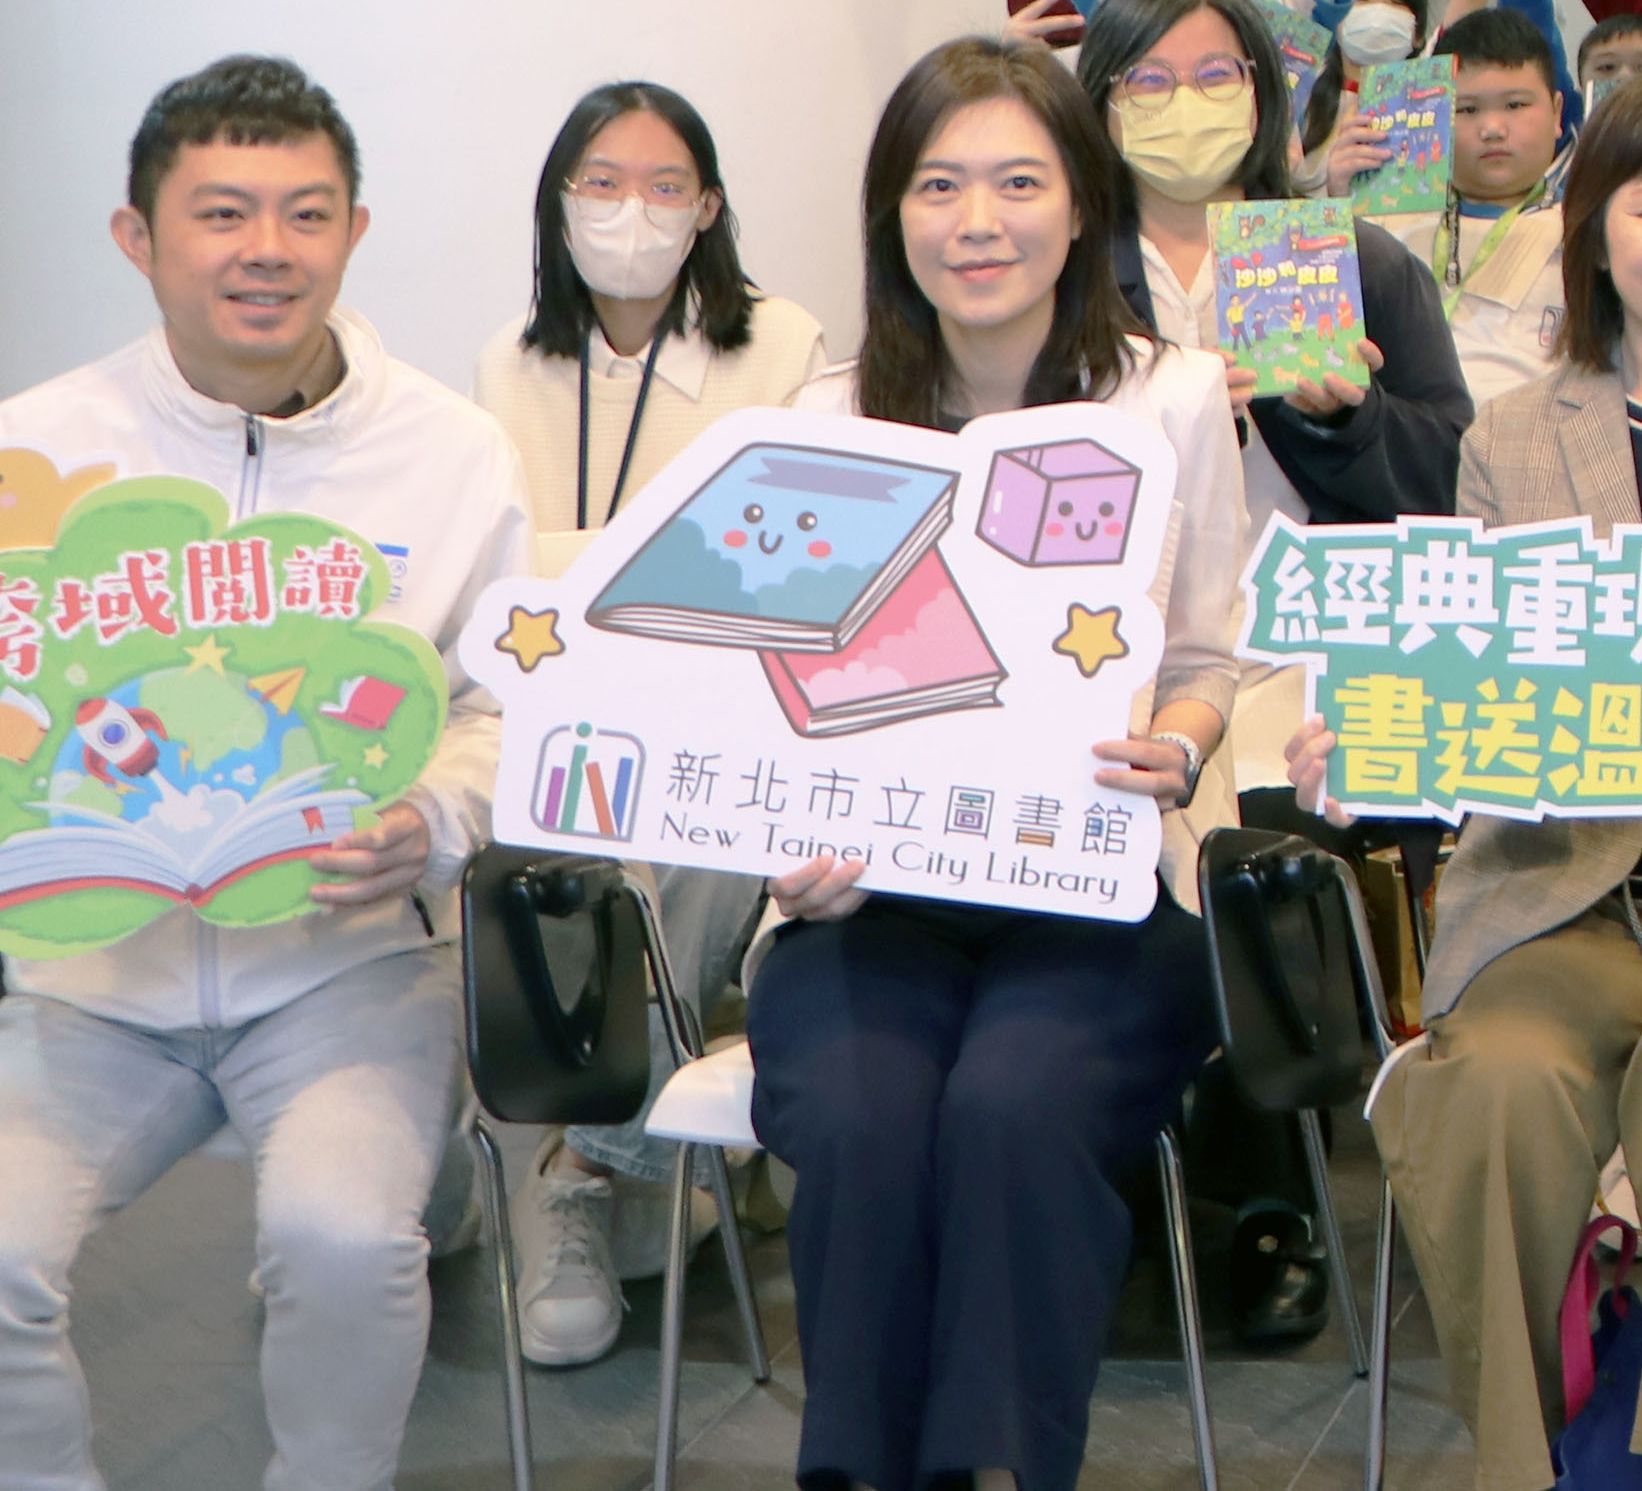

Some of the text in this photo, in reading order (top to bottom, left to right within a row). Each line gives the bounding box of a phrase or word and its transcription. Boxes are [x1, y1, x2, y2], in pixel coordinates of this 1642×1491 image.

[1235, 260, 1339, 289] 沙沙和皮皮
[665, 749, 1133, 858] 新北市立圖書館
[659, 812, 1119, 905] New Taipei City Library
